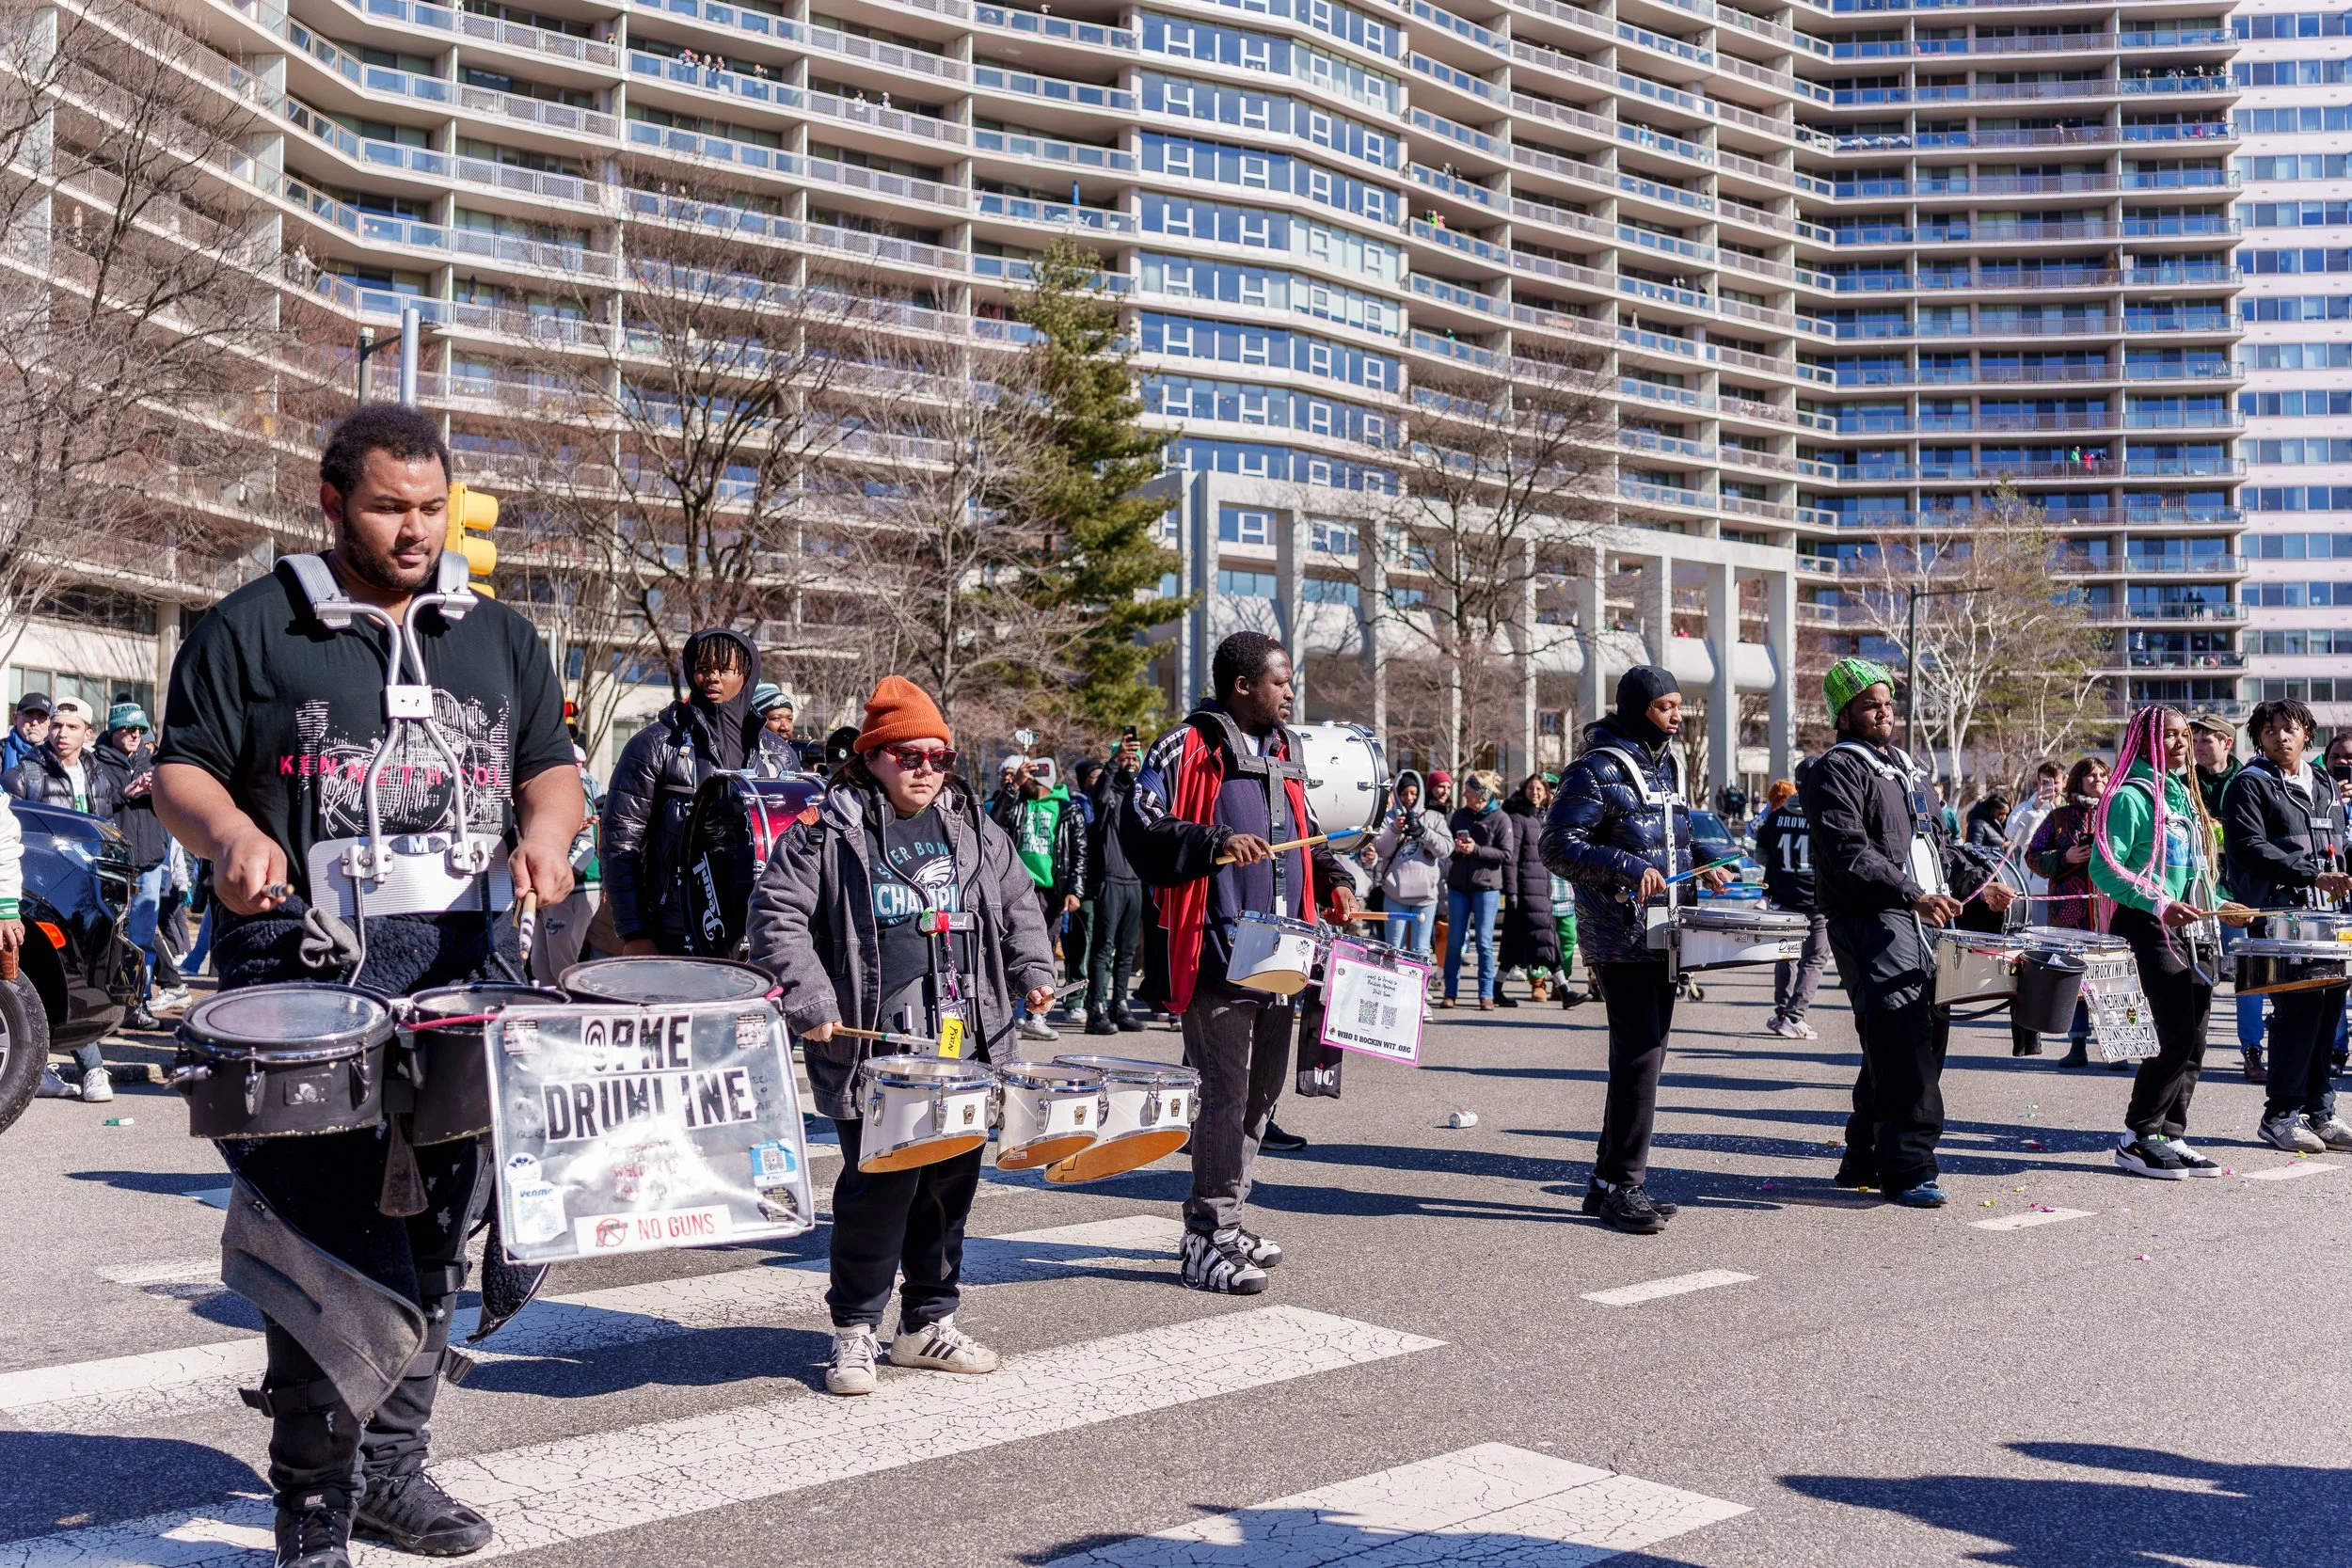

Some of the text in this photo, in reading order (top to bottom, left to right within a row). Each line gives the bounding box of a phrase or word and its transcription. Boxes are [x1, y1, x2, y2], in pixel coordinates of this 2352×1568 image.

[279, 755, 442, 785] KENNETH
[408, 836, 430, 854] M
[1777, 833, 1814, 873] 11
[692, 851, 725, 942] Pearl
[1337, 1030, 1354, 1041] WHO
[1383, 1041, 1396, 1051] WIT
[544, 1070, 753, 1139] DRUMLINE
[639, 1212, 715, 1241] NO GUNS
[305, 1495, 324, 1506] NIKE
